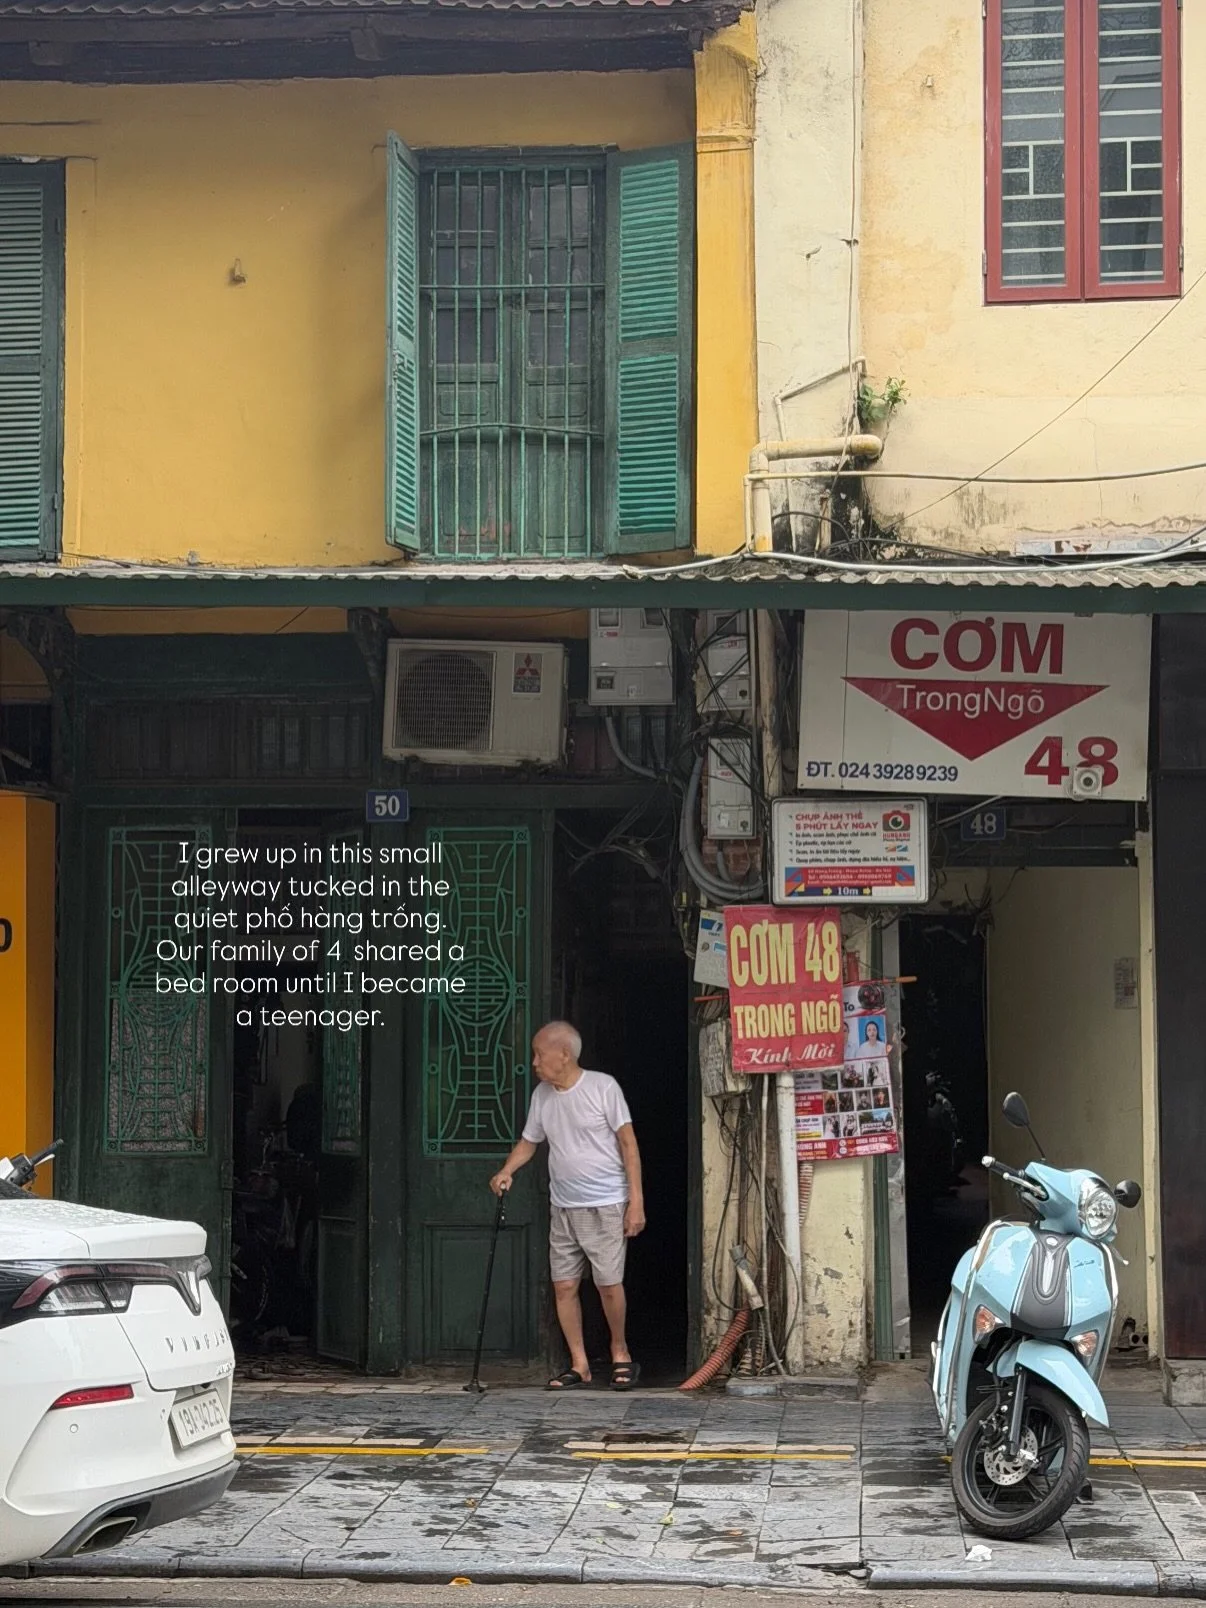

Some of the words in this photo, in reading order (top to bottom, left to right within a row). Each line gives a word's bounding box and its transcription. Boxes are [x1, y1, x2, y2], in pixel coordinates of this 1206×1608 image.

[891, 616, 1065, 675] CƠM
[1024, 736, 1119, 786] 48
[374, 794, 401, 817] 50
[852, 821, 879, 830] NGAY
[970, 812, 997, 836] 48
[836, 887, 859, 897] 10m
[730, 919, 796, 987] CƠM
[805, 920, 840, 983] 48
[733, 1001, 797, 1040] TRONG
[800, 994, 841, 1036] NGÕ
[744, 1045, 792, 1065] Kính
[796, 1042, 836, 1061] Mời
